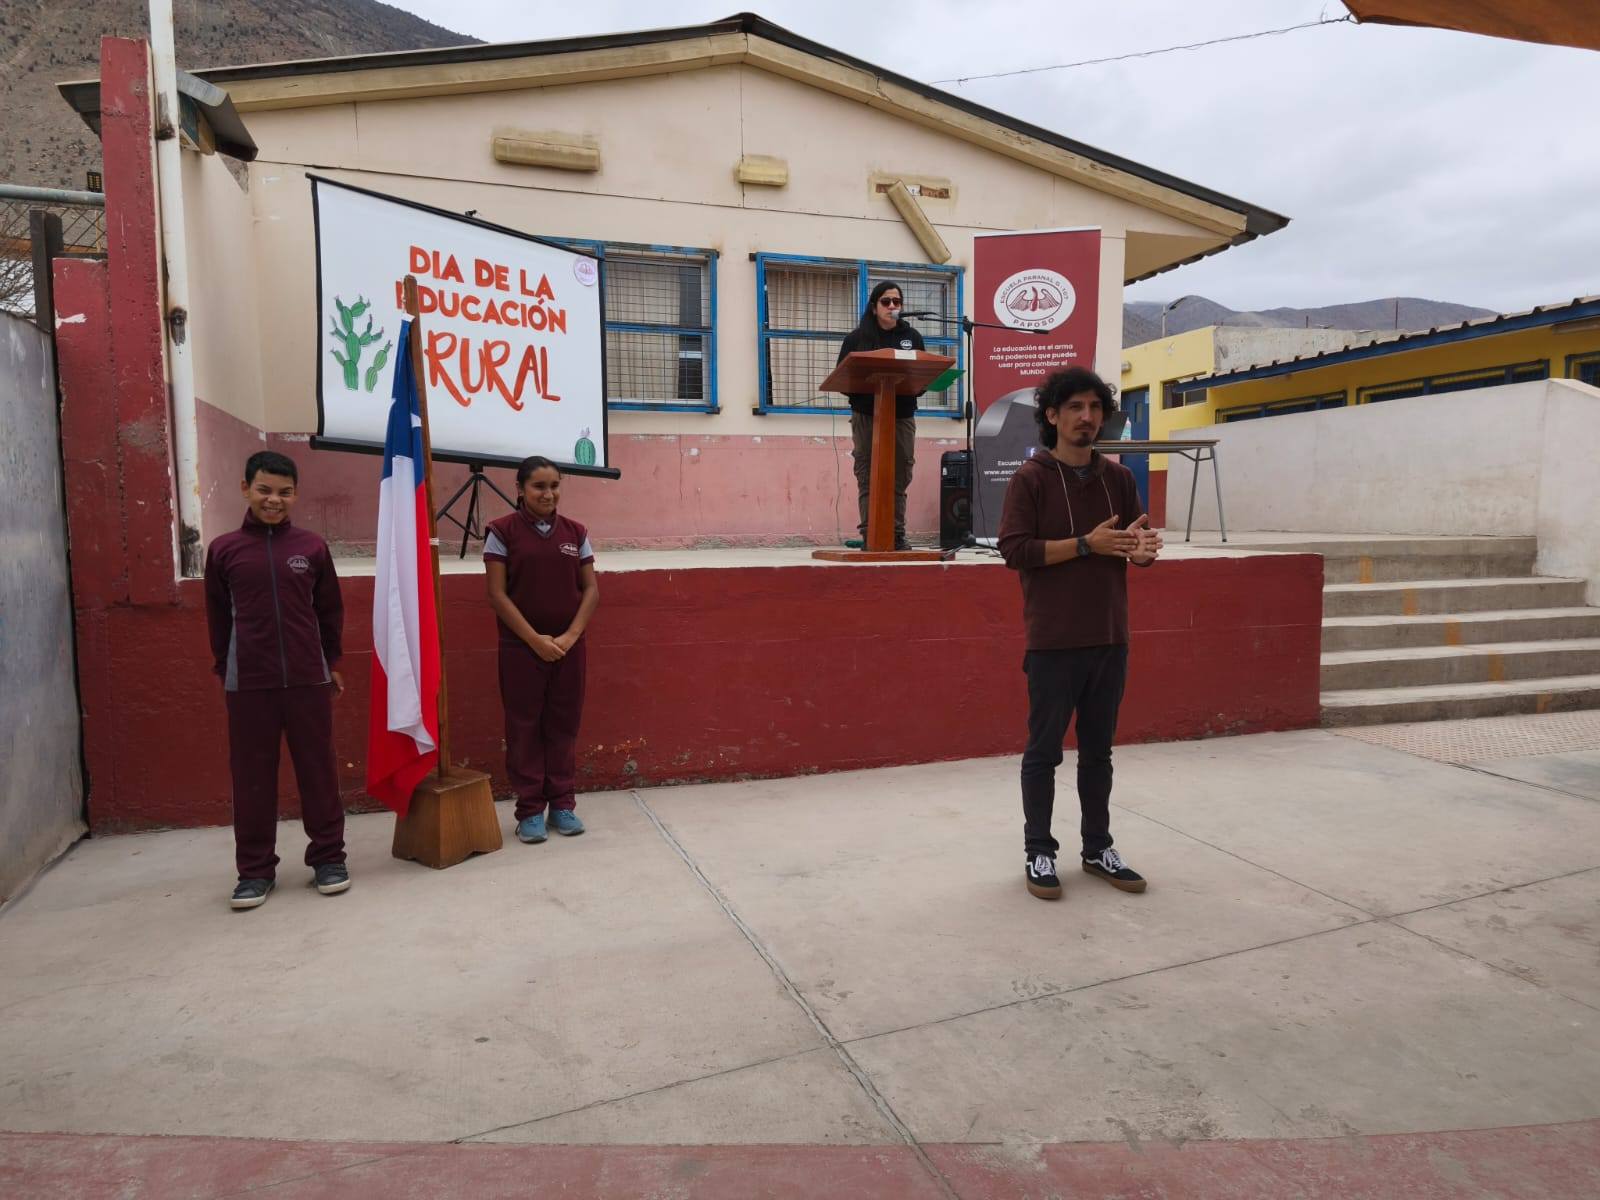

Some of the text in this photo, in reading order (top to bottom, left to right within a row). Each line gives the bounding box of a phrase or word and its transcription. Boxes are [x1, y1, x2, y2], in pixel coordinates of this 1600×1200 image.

[409, 245, 465, 283] DIA
[474, 258, 510, 291] DE
[519, 268, 555, 301] LA
[1000, 278, 1022, 304] ESCUELA
[1023, 274, 1053, 283] PARANAL
[1013, 317, 1055, 328] PAPOSO
[1002, 344, 1037, 352] educación
[1005, 353, 1037, 361] poderosa
[1052, 351, 1077, 360] puedes
[424, 329, 561, 411] RURAL
[1014, 361, 1030, 369] para
